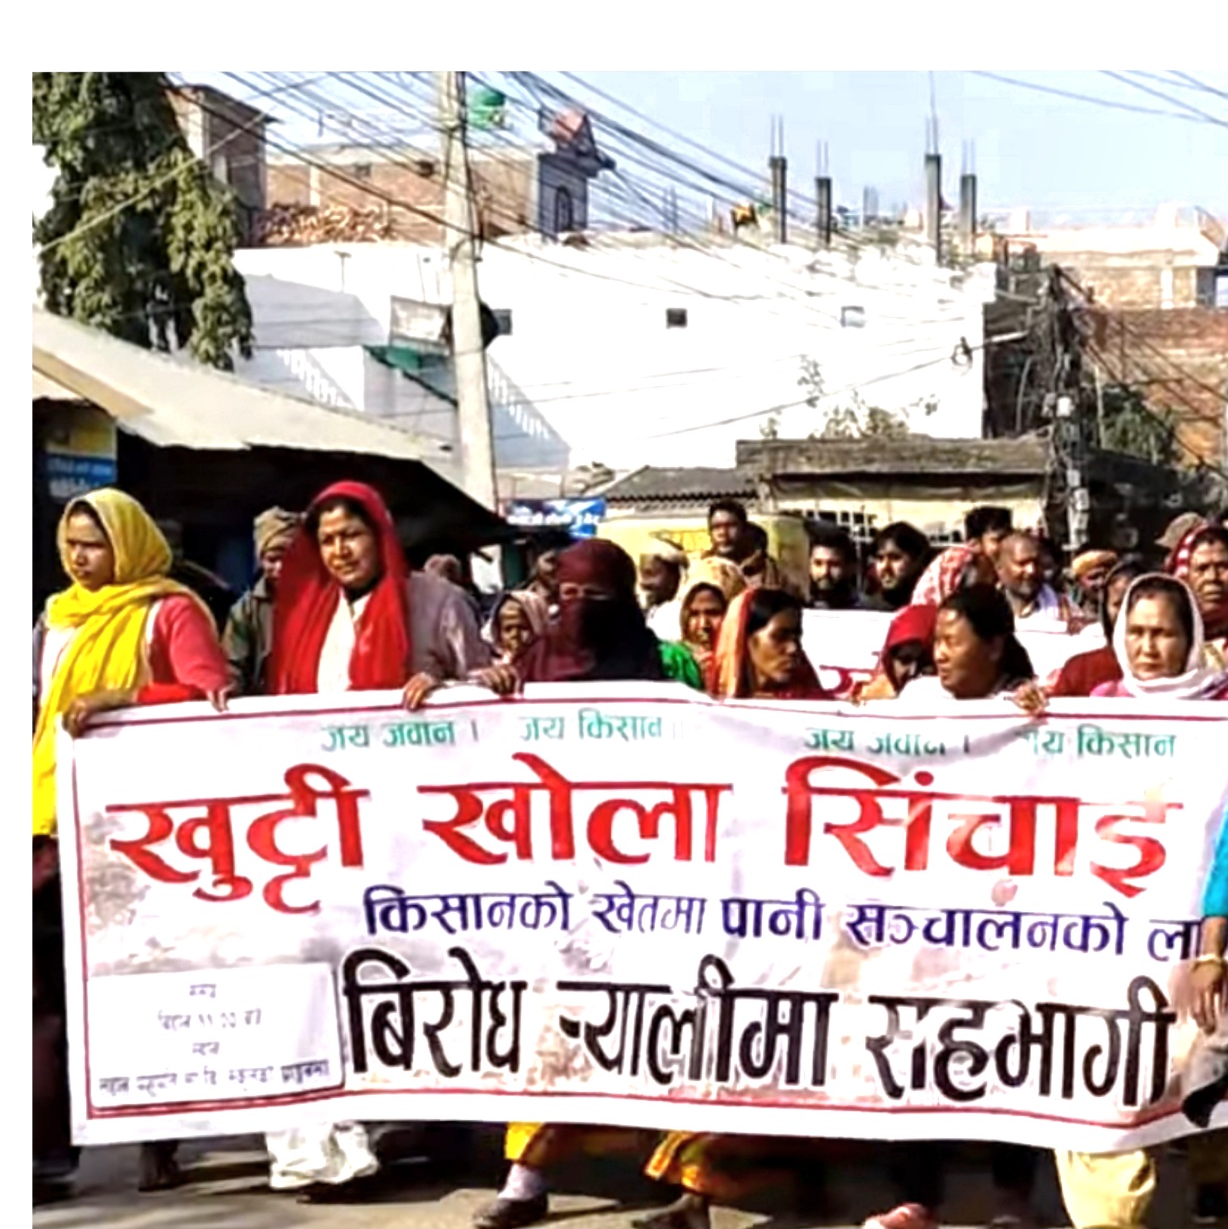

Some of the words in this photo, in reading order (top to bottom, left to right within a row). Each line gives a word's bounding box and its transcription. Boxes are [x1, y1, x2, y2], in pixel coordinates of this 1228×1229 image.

[320, 723, 370, 752] जय
[382, 719, 456, 748] जवान
[520, 716, 565, 742] जय
[804, 728, 855, 752] जय
[1077, 722, 1178, 758] किसान
[105, 762, 371, 914] खुट्टी
[416, 752, 733, 866] खोला
[364, 882, 574, 936] किसानको
[592, 882, 706, 935] खेतमा
[720, 888, 825, 941] पानी
[344, 946, 528, 1076] बिरोध
[863, 975, 1179, 1109] सहभागी
